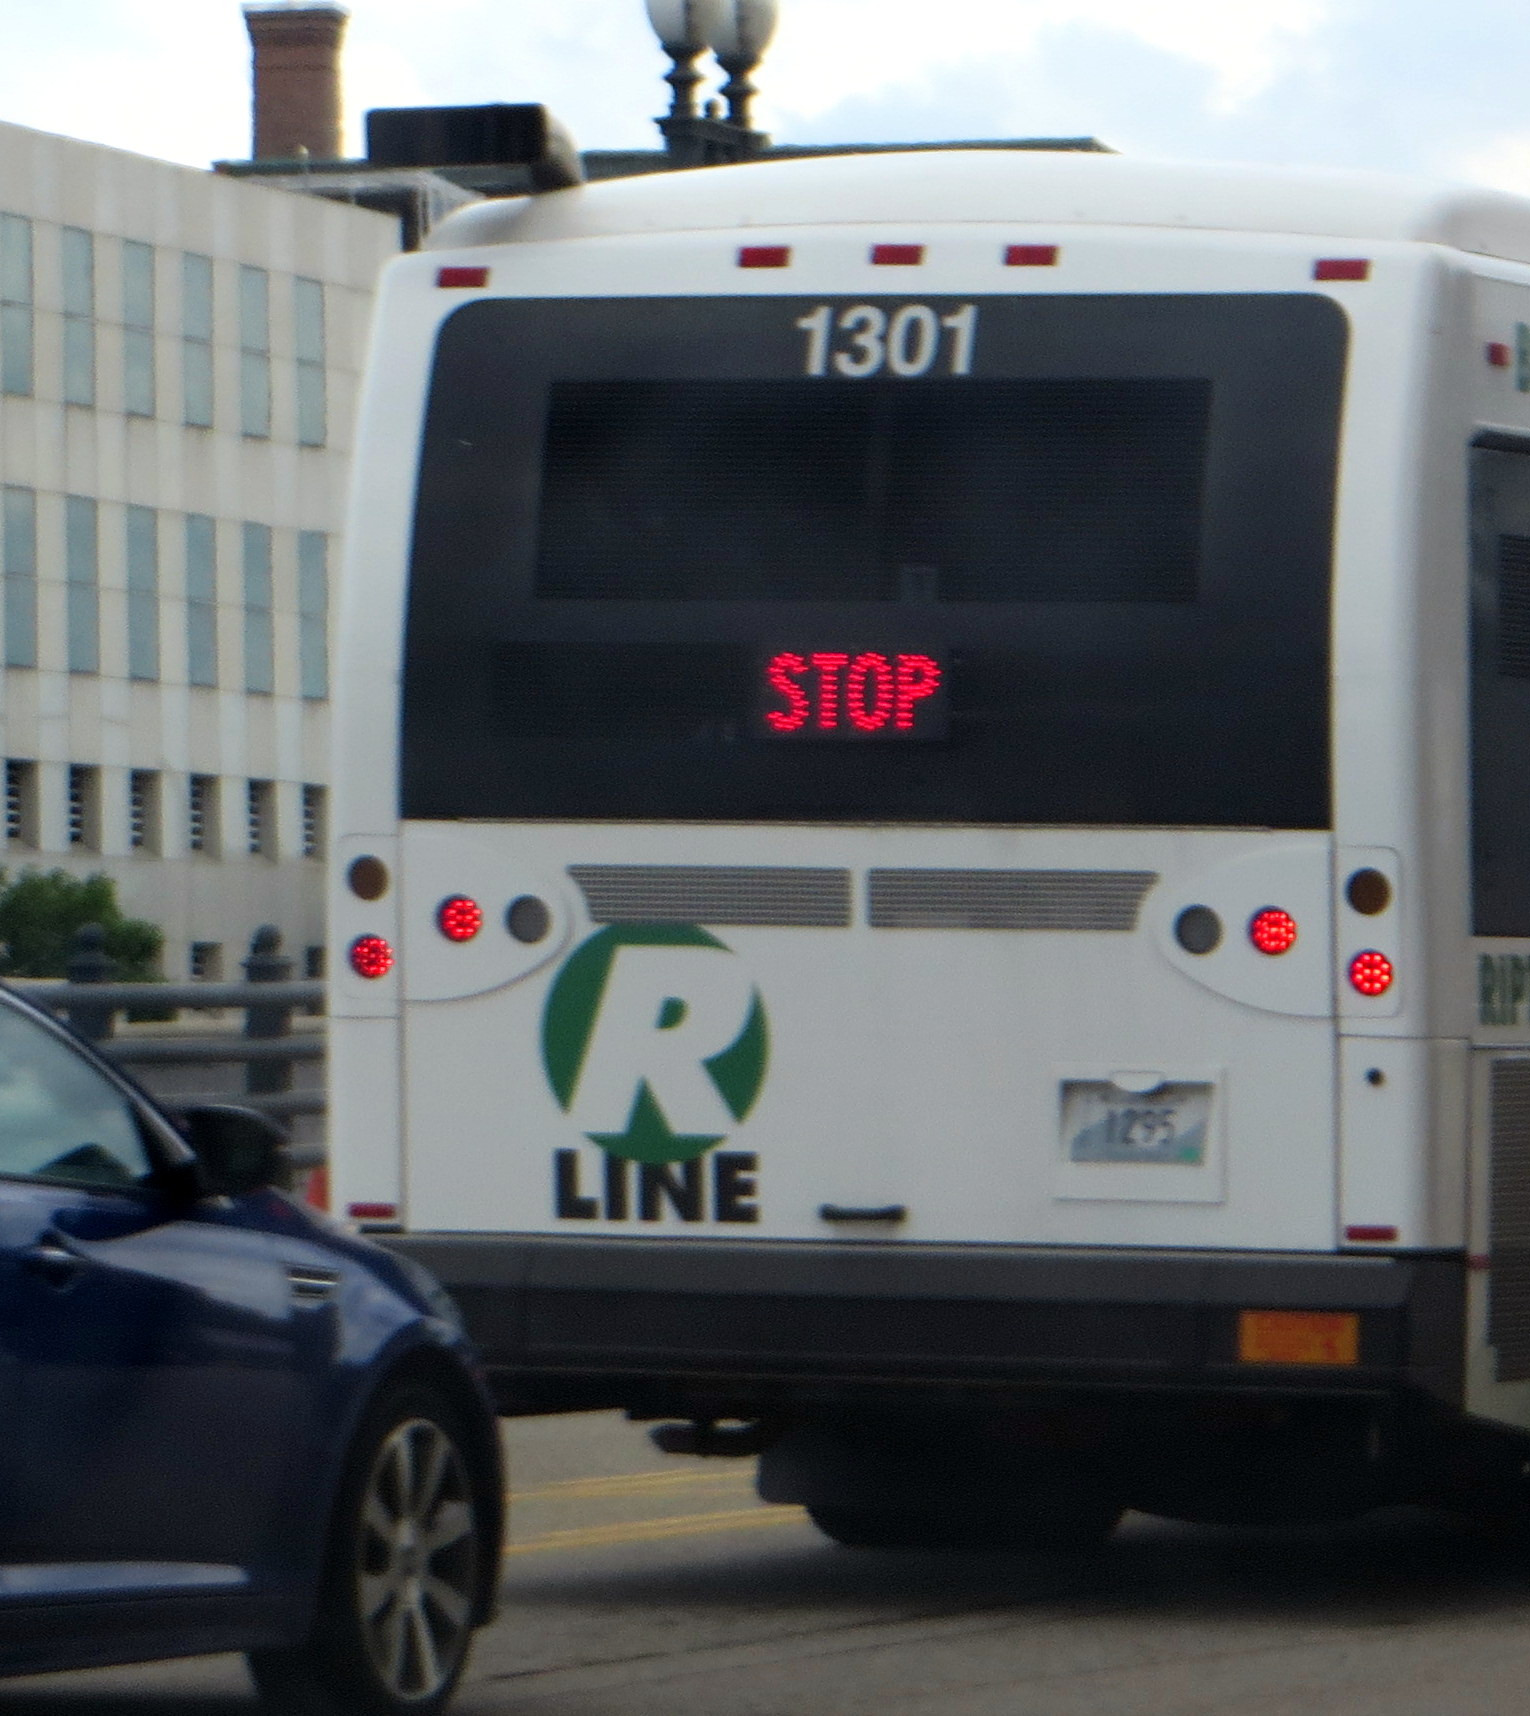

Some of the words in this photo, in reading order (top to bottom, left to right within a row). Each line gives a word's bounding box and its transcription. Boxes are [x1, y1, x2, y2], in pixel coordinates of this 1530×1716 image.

[797, 304, 979, 377] 1301
[766, 652, 941, 731] STOP
[562, 944, 756, 1136] R
[555, 1148, 760, 1222] LINE
